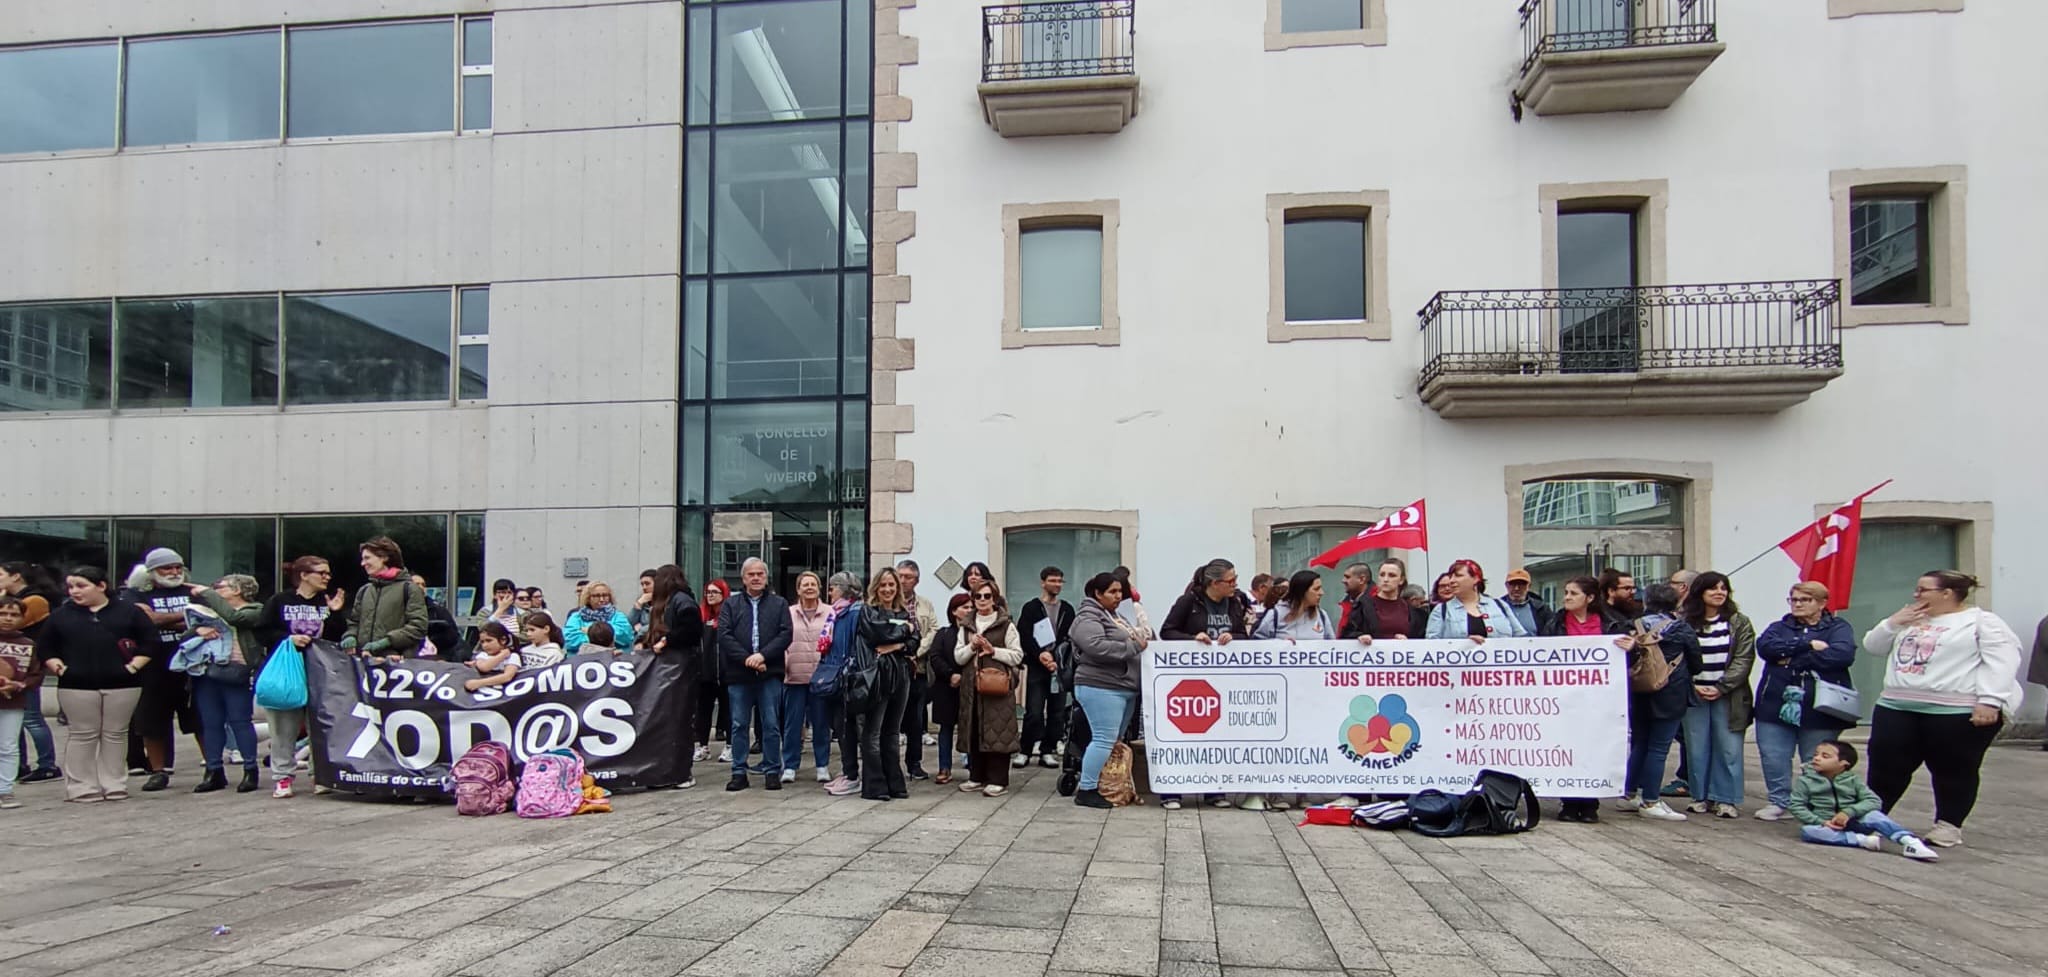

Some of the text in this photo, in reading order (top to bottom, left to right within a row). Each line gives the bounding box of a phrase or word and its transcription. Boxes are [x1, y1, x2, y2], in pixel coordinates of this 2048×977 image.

[756, 427, 827, 439] CONCELLO
[780, 449, 798, 460] DE
[765, 472, 817, 482] VIVEIRO
[1154, 647, 1609, 665] NECESIDADES ESPECÍFICAS DE APOYO EDUCATIVO
[1325, 669, 1609, 689] ¡SUS DERECHOS, NUESTRA LUCHA!
[1169, 696, 1219, 717] STOP
[1228, 690, 1277, 705] RECORTES EN
[1455, 694, 1560, 715] MÁS RECURSOS
[1228, 708, 1277, 726] EDUCACIÓN
[1455, 719, 1541, 741] MÁS APOYOS
[1151, 747, 1329, 765] #PORUNAEDUCACIONDIGNA
[1337, 742, 1423, 770] ASFANEMOR
[1456, 744, 1573, 767] MÁS INCLUSIÓN
[1154, 772, 1218, 785] ASOCIACIÓN
[1222, 774, 1233, 784] DE
[1238, 774, 1284, 784] FAMILIAS
[1288, 774, 1399, 785] NEURODIVERGENTES
[1403, 775, 1417, 785] DE
[1420, 776, 1434, 785] LA
[1438, 774, 1475, 785] MARIÑ
[1545, 778, 1552, 787] Y
[1557, 778, 1614, 789] ORTEGAL
